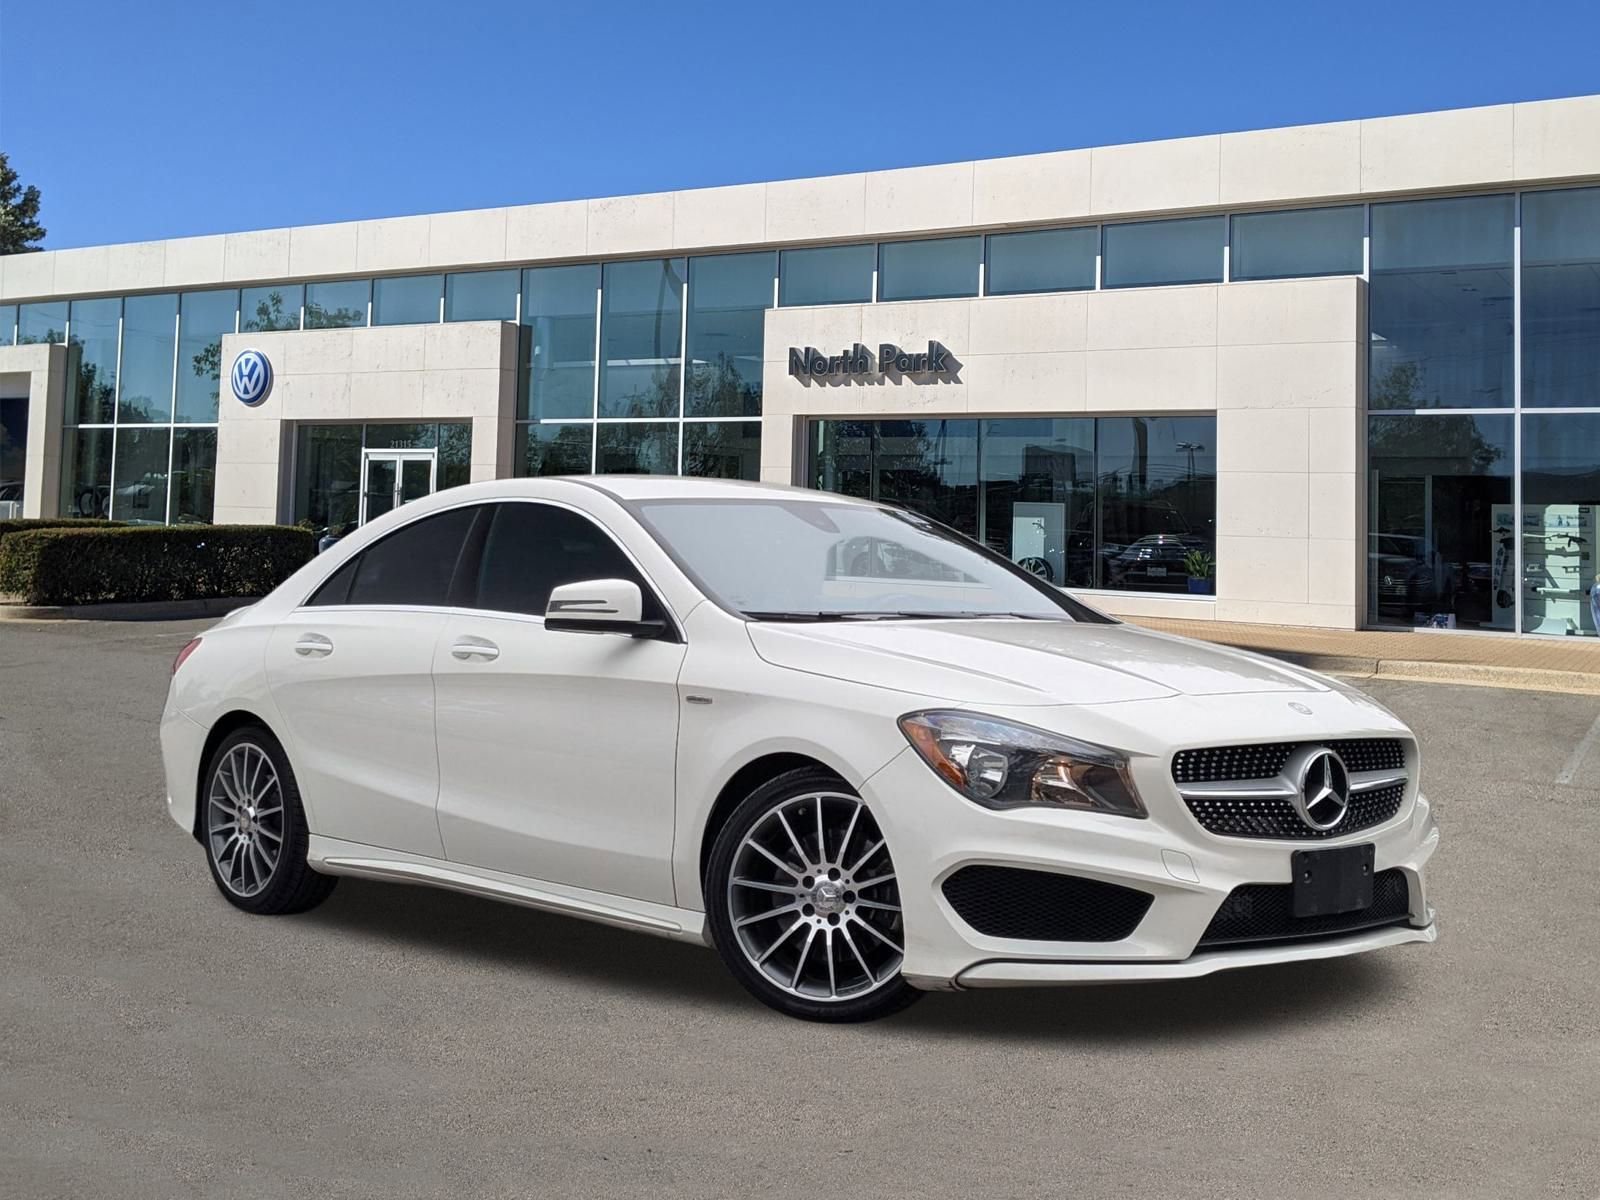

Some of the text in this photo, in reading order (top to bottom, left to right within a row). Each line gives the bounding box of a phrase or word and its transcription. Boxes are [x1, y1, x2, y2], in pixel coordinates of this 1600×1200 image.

[788, 340, 948, 376] North Park
[390, 440, 412, 449] 21315
